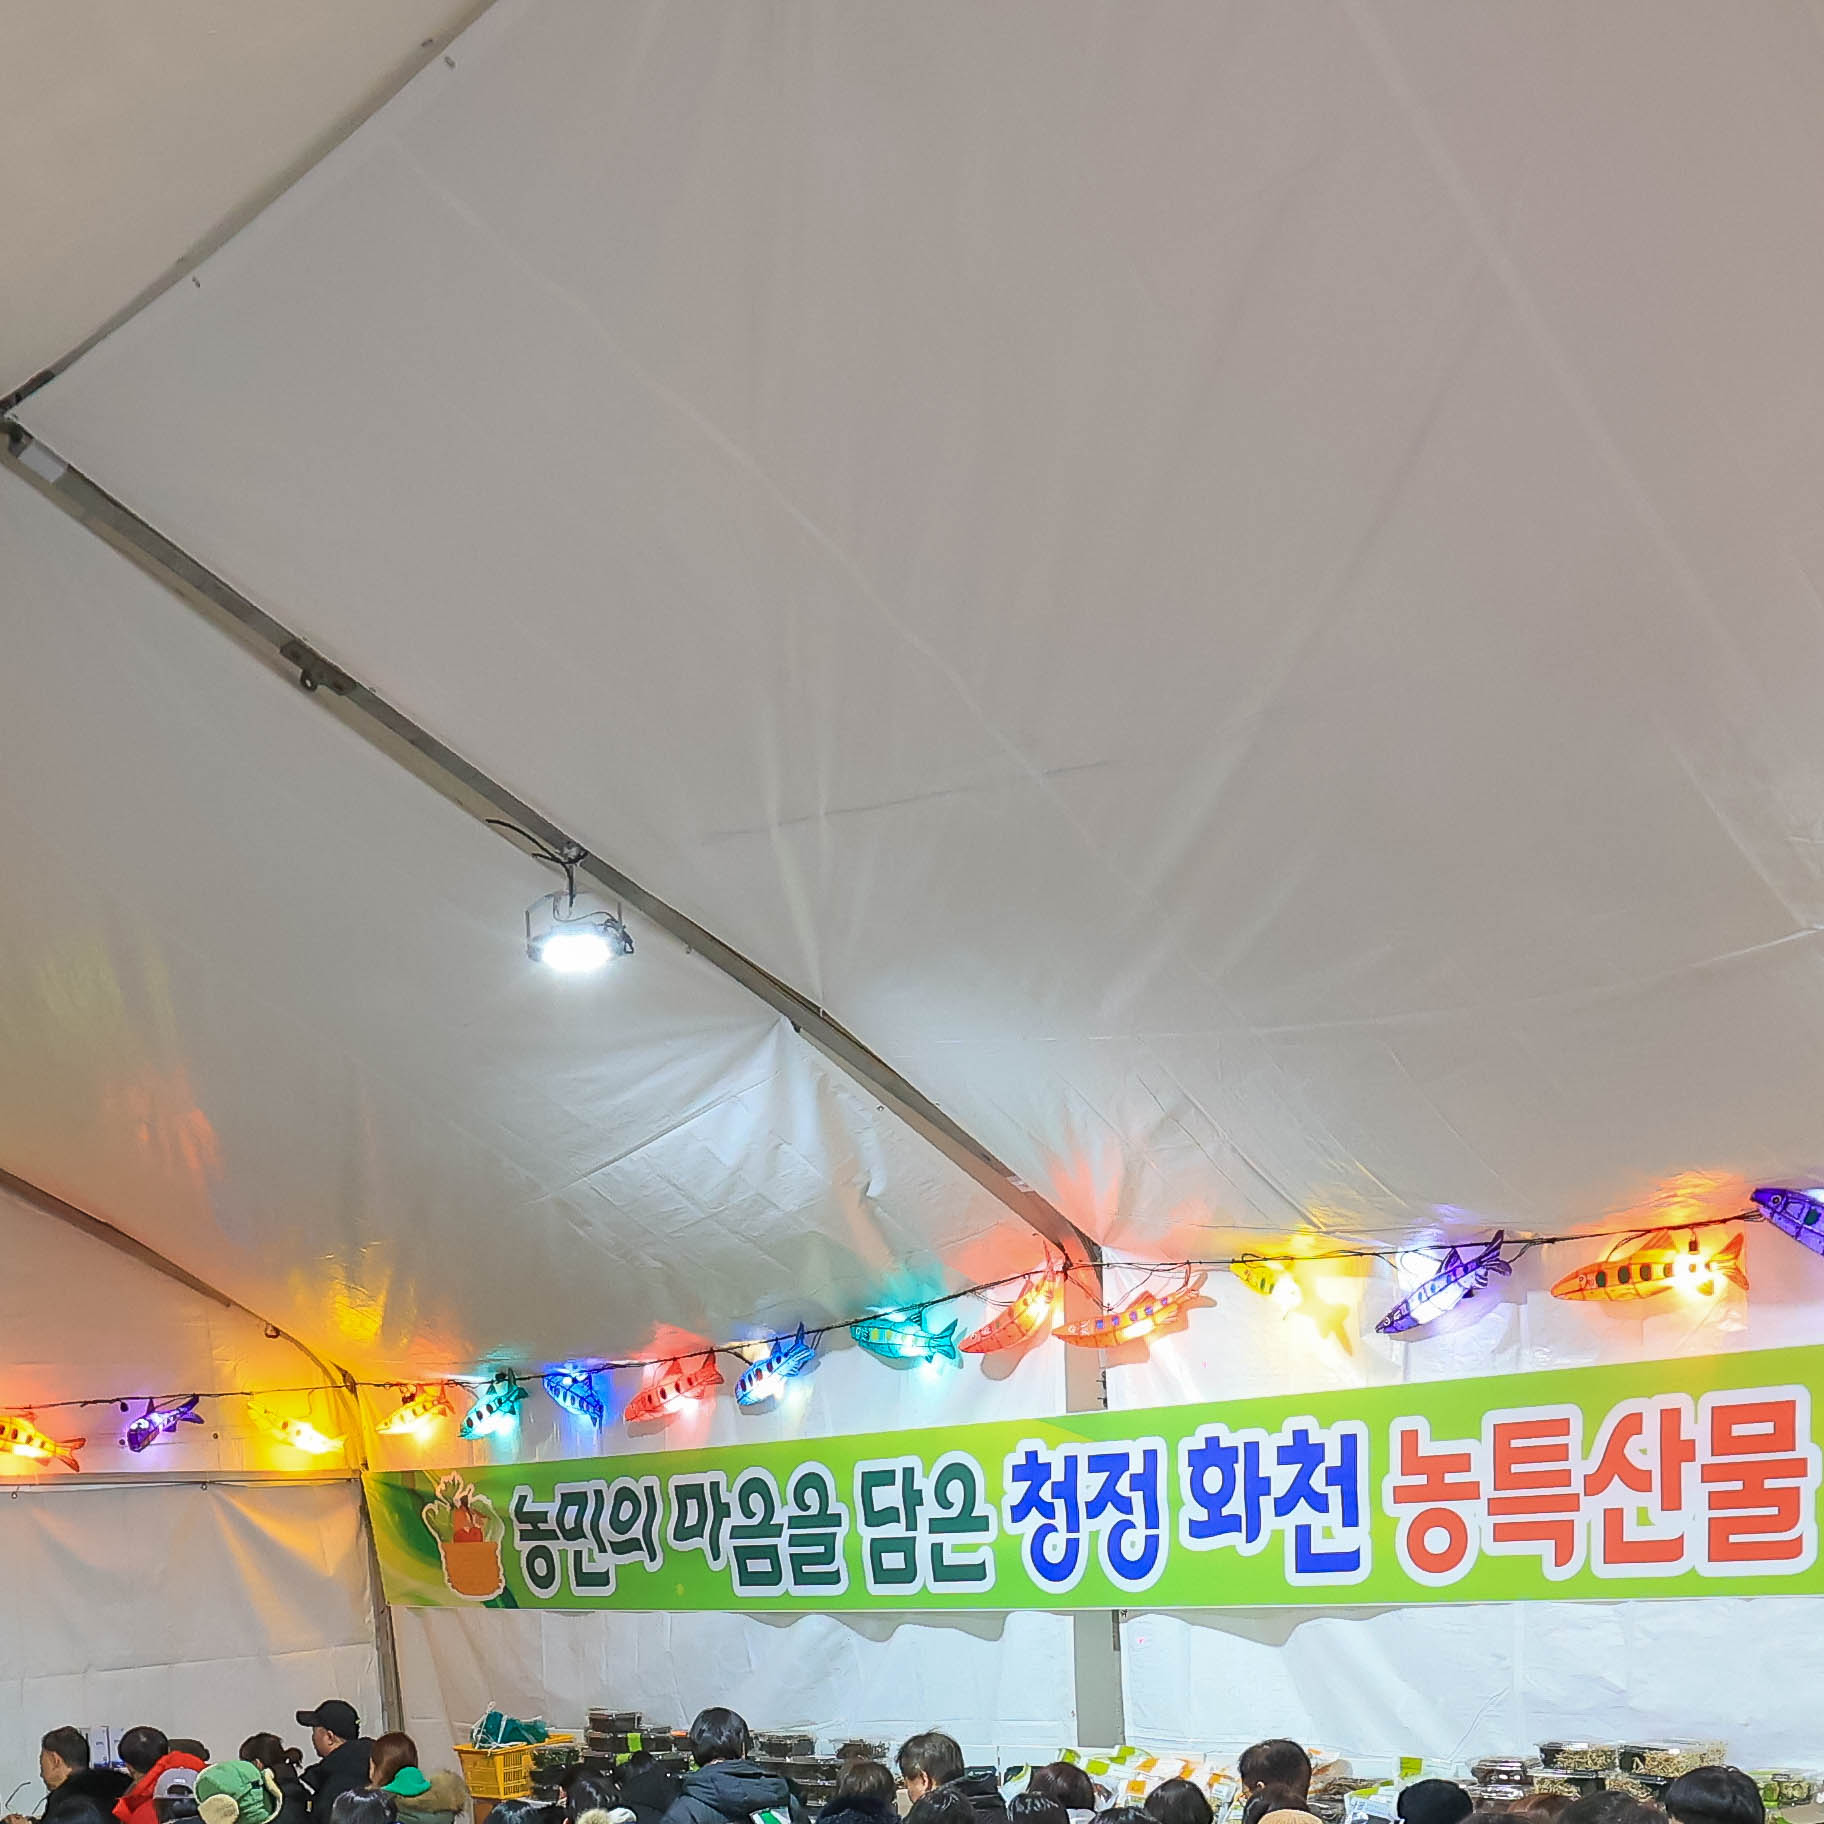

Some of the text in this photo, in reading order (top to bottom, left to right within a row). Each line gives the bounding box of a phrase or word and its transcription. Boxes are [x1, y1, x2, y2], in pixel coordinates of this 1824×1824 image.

[513, 1477, 657, 1588] 농민의
[671, 1466, 844, 1589] 마음을
[861, 1464, 990, 1587] 담은
[1010, 1448, 1165, 1580] 청정
[1186, 1427, 1360, 1575] 화천
[1390, 1396, 1811, 1574] 농특산물
